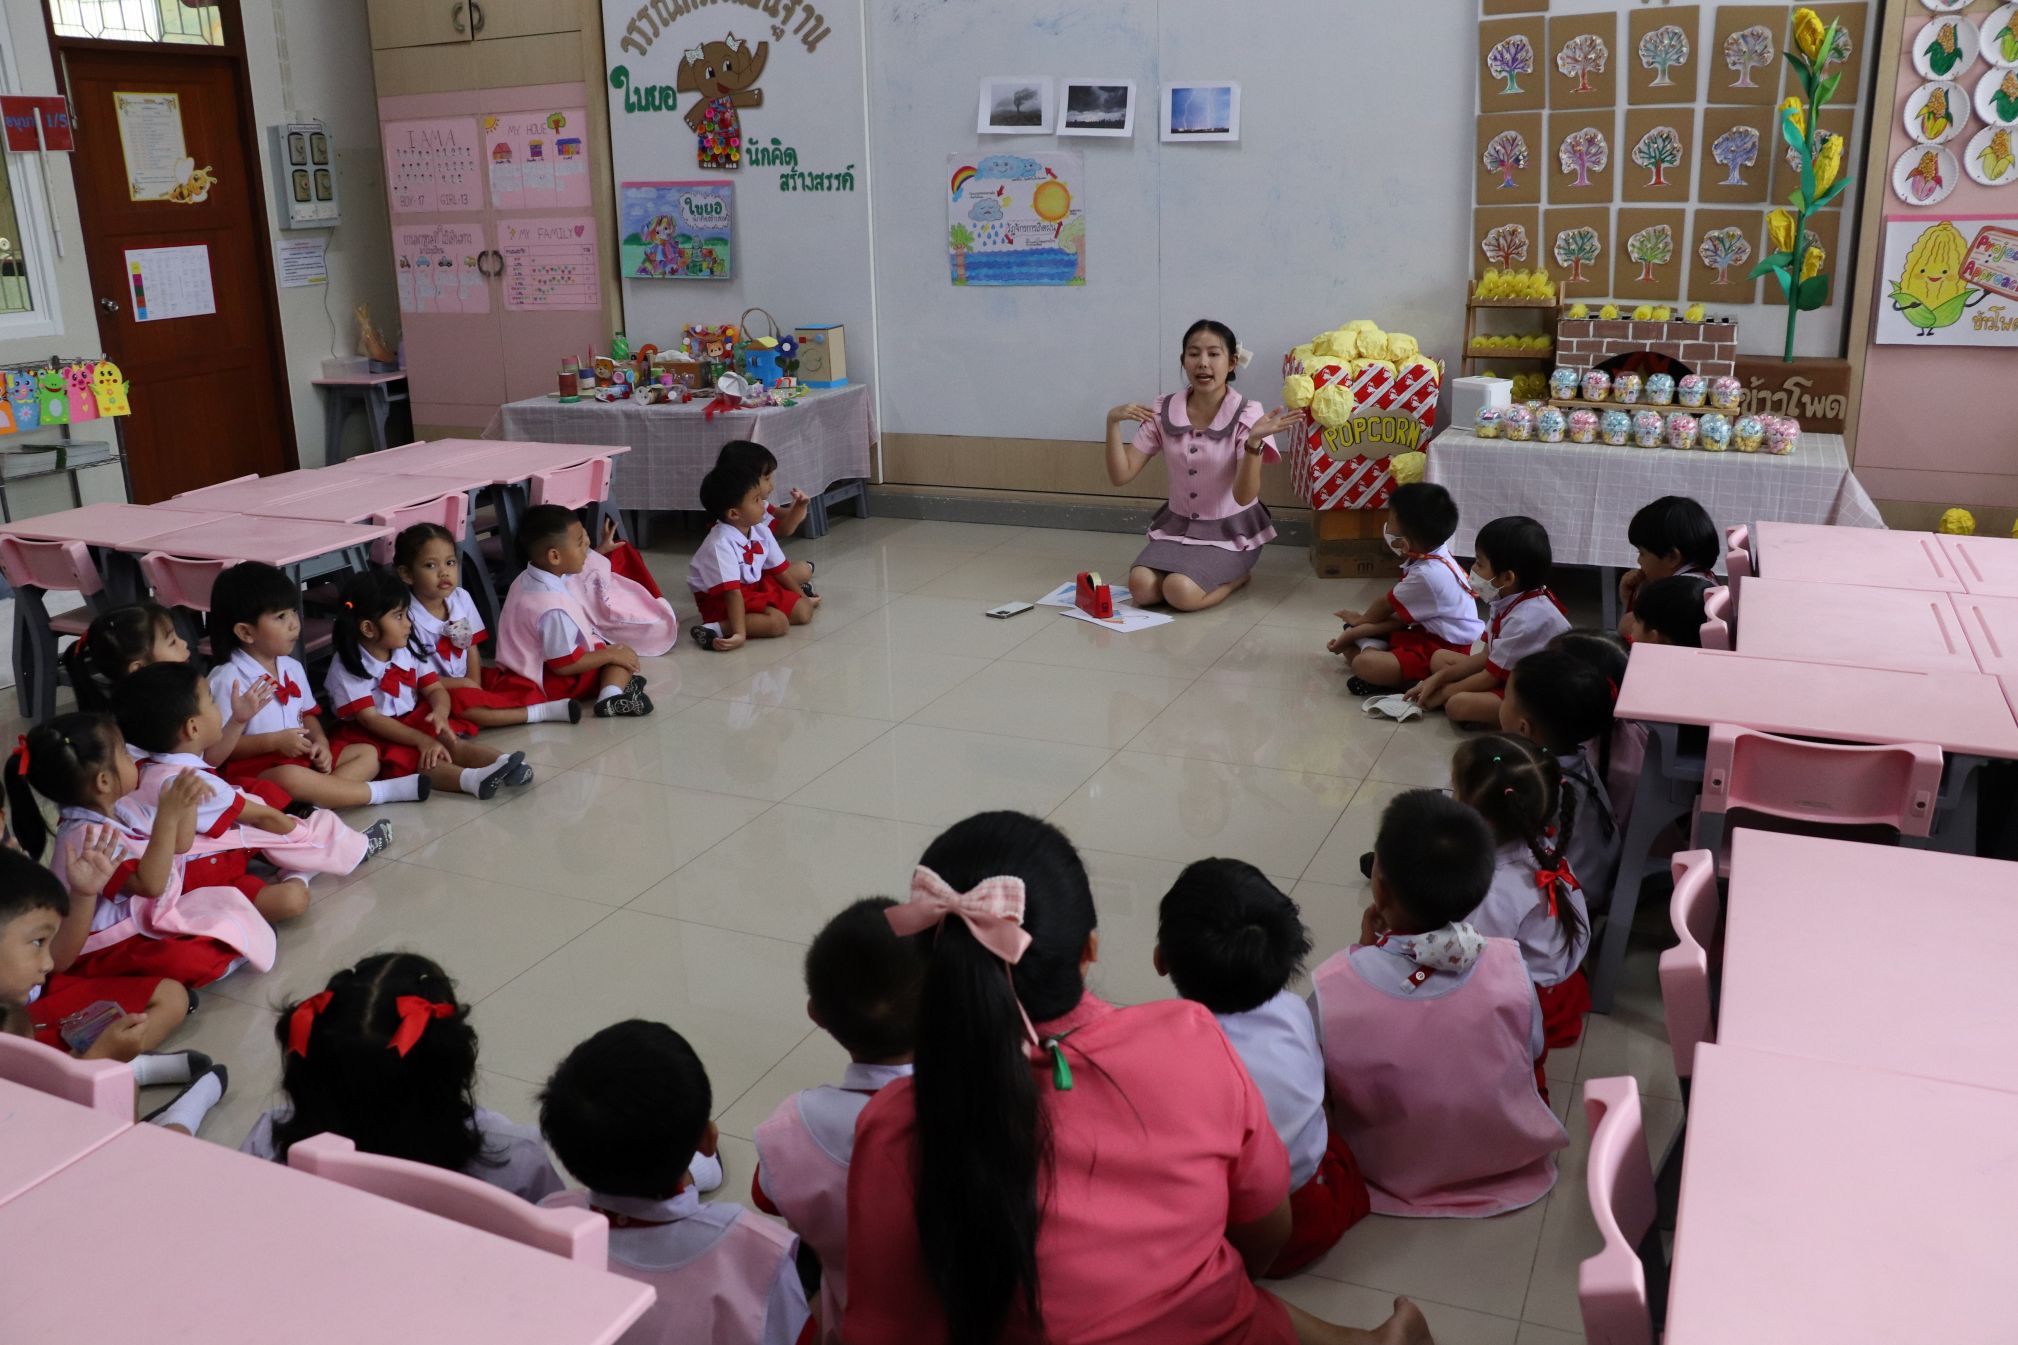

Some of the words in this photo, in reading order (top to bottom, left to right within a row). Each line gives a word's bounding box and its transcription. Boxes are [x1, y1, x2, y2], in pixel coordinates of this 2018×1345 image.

[610, 64, 677, 113] ใบยอ
[745, 137, 798, 166] นักคิด
[779, 164, 855, 192] สร้างสรรค์
[684, 196, 723, 216] ใบยอ
[537, 227, 573, 240] FAMILY
[1739, 376, 1848, 420] ข้าวโพด
[1323, 416, 1422, 453] POPCORN
